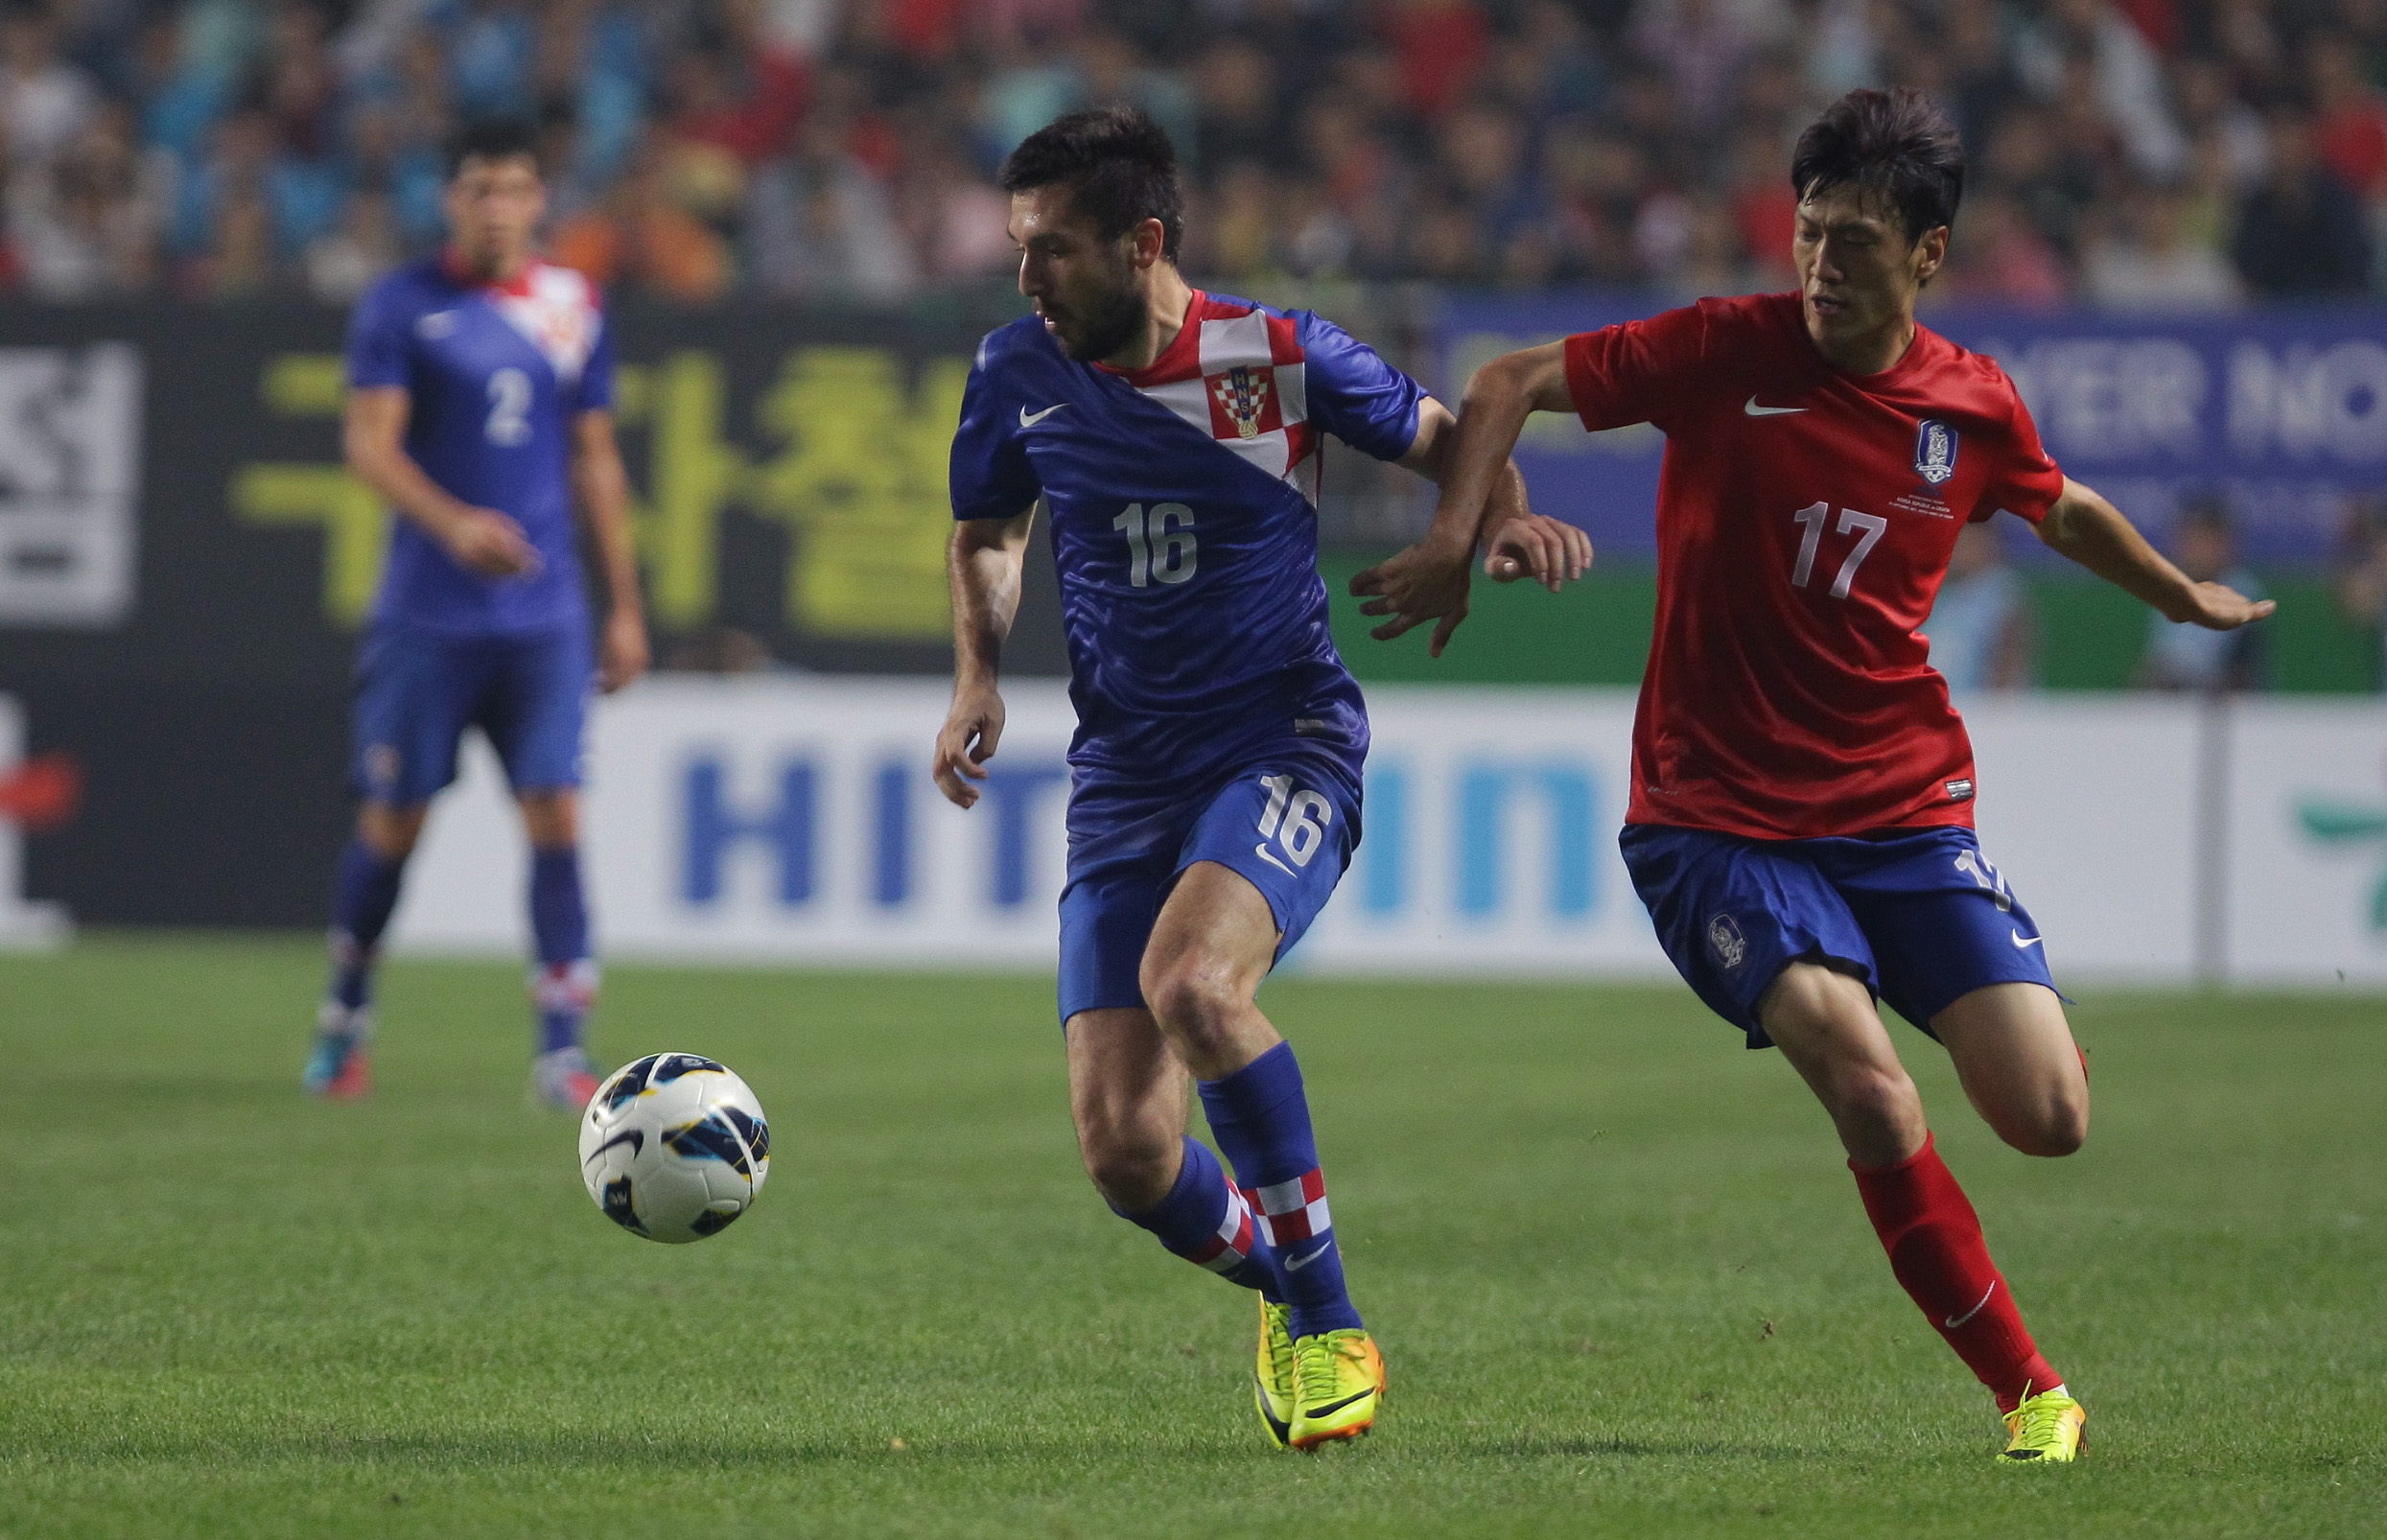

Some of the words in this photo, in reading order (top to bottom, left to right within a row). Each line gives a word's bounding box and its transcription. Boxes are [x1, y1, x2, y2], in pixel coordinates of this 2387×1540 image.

[483, 368, 534, 449] 2
[1112, 502, 1198, 588] 16
[1791, 501, 1887, 600] 17
[677, 753, 1070, 913] HIT
[1257, 774, 1333, 868] 16
[1954, 849, 2011, 913] 17
